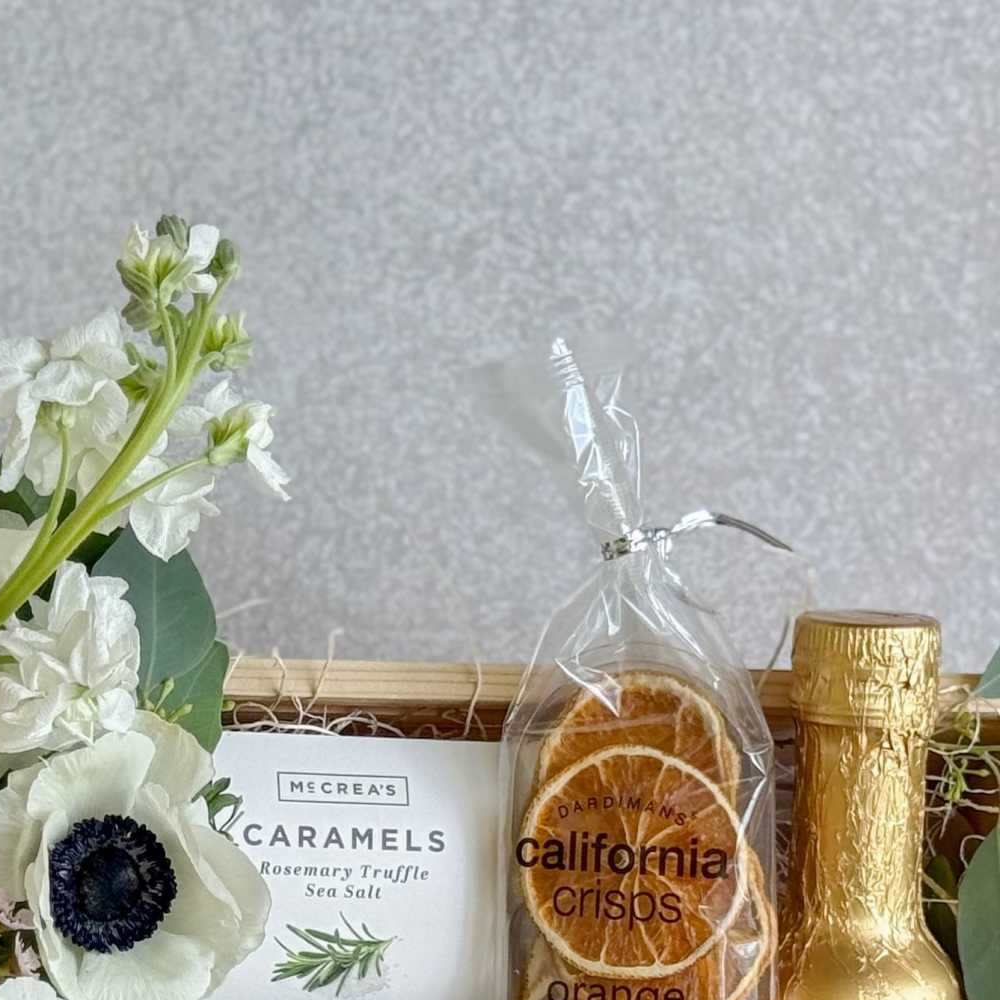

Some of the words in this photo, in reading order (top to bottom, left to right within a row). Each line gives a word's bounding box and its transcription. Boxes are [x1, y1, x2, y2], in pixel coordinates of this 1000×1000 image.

[242, 823, 446, 852] CARAMELS
[515, 830, 730, 880] california
[260, 861, 353, 881] Rosemary
[360, 864, 430, 883] Truffle
[304, 883, 337, 898] Sea
[343, 884, 382, 899] Salt
[552, 879, 682, 931] crisps
